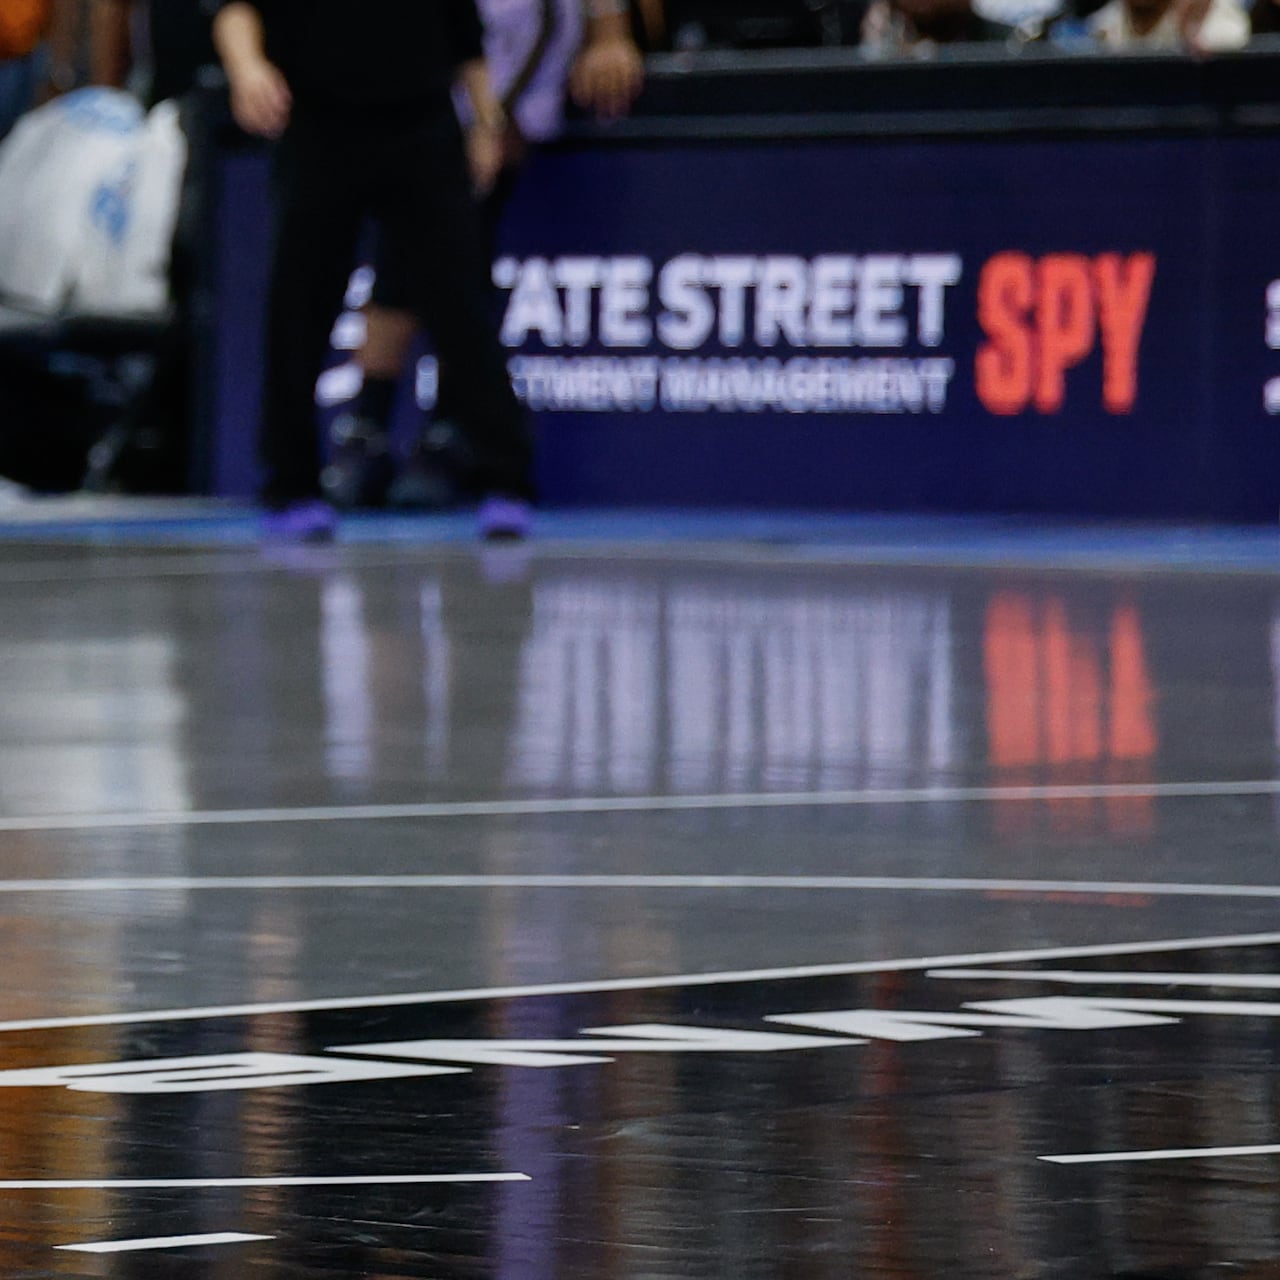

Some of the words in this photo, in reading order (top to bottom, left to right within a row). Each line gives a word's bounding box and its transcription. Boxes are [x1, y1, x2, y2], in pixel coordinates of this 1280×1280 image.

[656, 252, 962, 350] STREET
[975, 250, 1157, 415] SPY
[659, 355, 955, 414] MANAGEMENT
